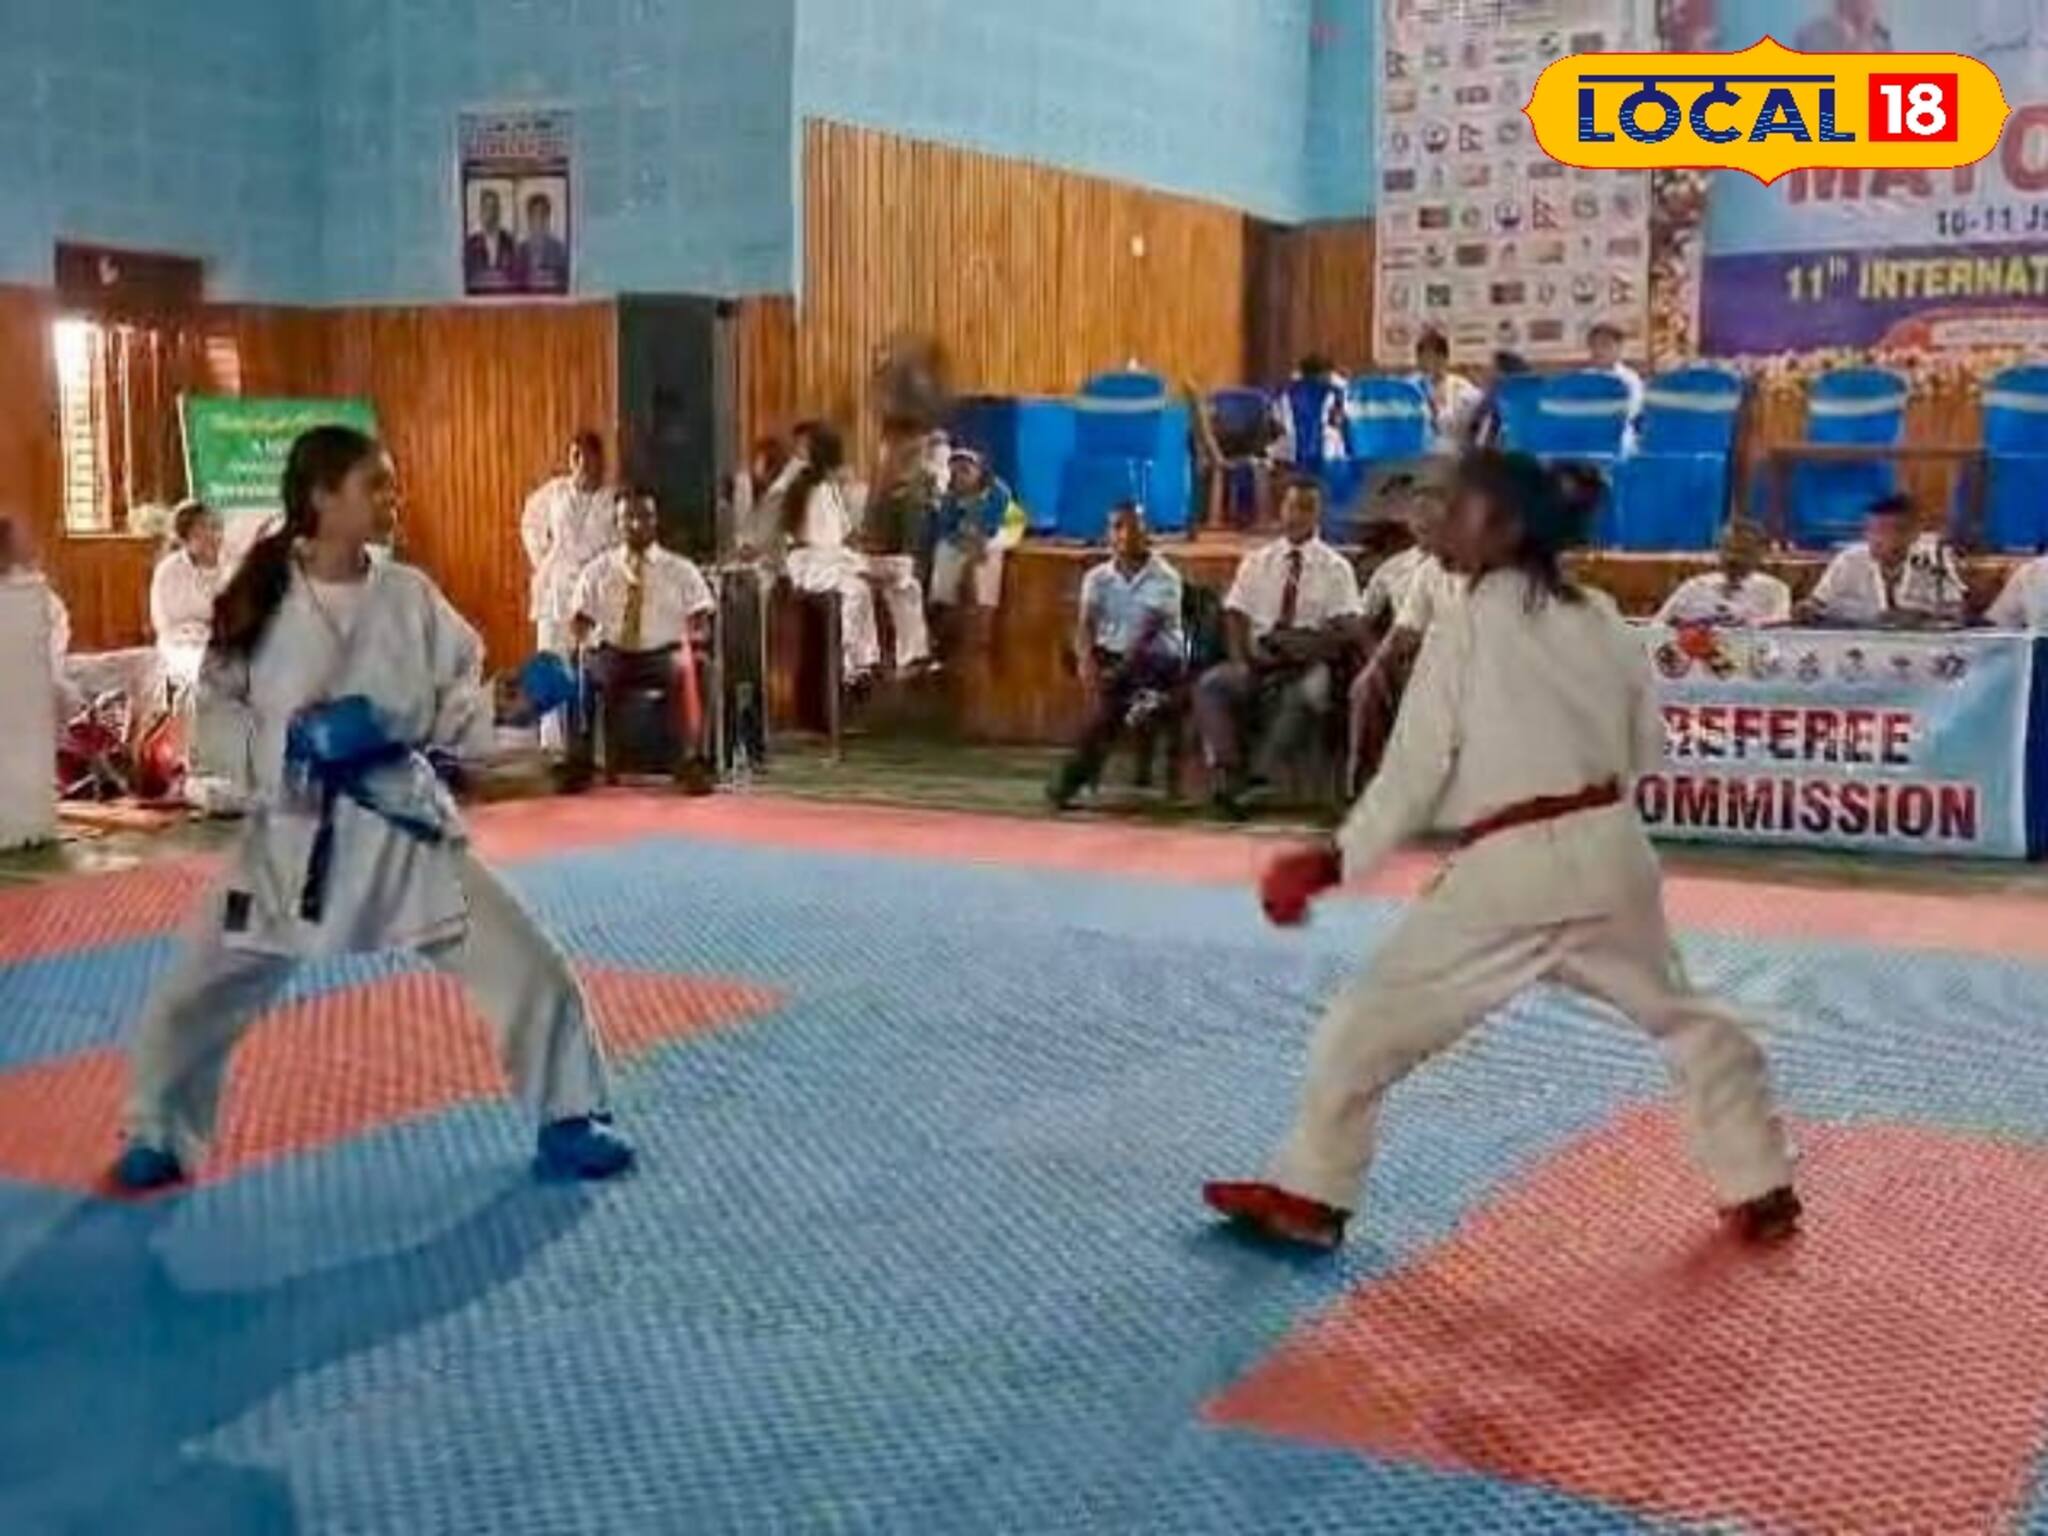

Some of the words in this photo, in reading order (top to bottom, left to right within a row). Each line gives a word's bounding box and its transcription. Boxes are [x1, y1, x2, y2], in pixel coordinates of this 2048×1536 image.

[1936, 206, 2011, 236] 10-11
[1663, 706, 1912, 764] REFEREE
[1636, 774, 1977, 840] OMMISSION
